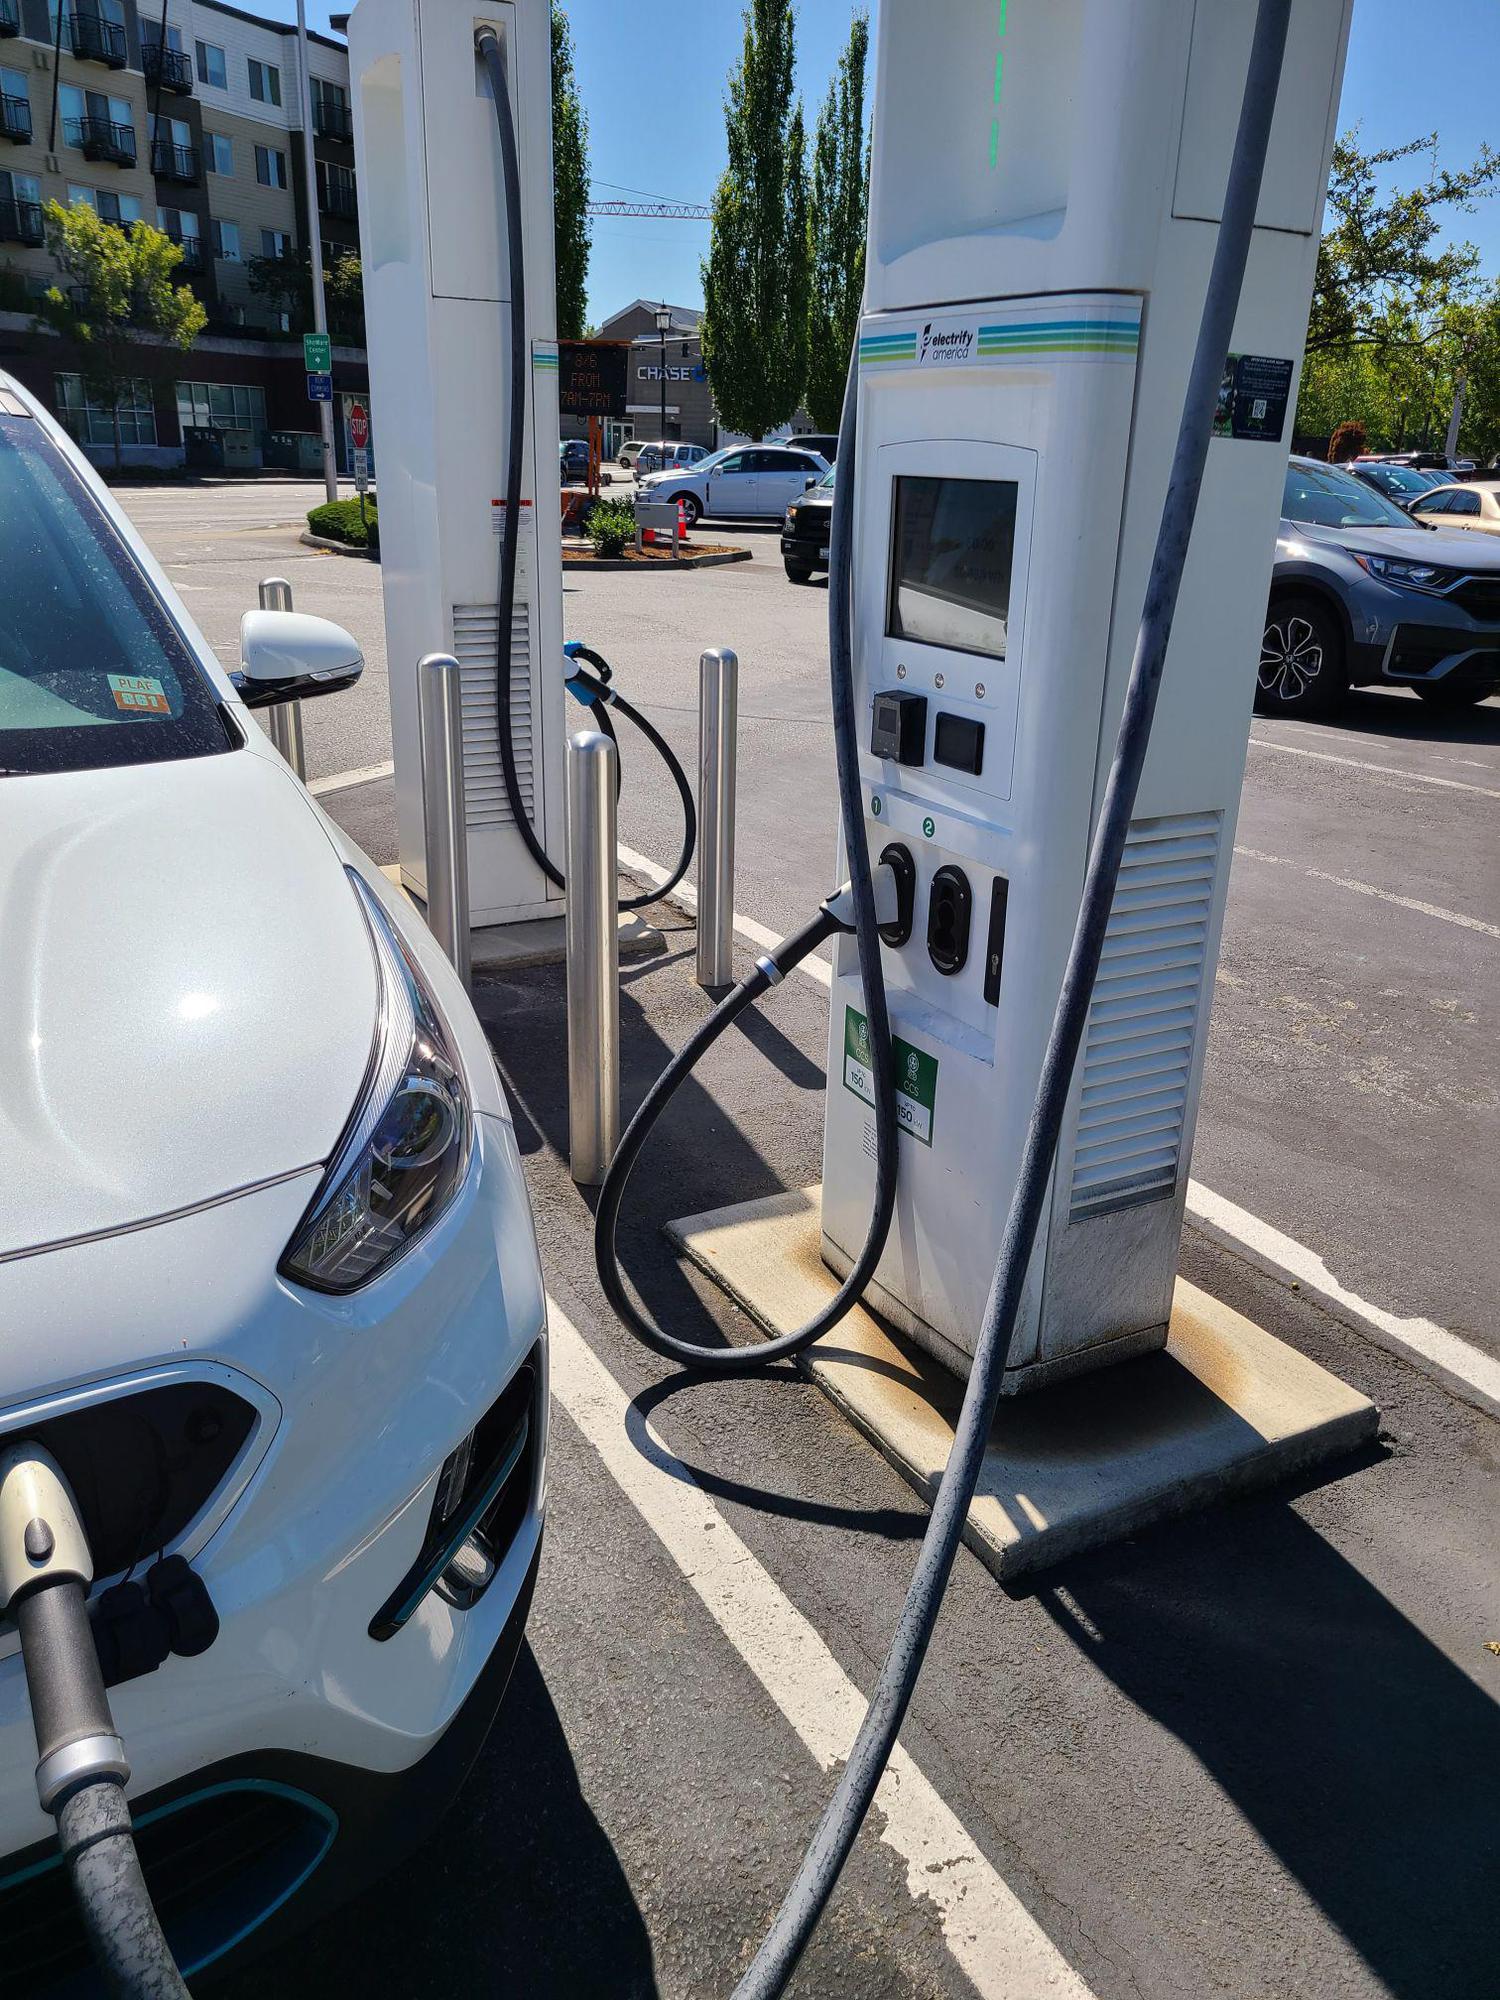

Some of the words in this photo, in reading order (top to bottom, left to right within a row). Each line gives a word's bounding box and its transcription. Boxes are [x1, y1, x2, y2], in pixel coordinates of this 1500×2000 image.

[932, 330, 973, 347] electrify
[932, 347, 969, 360] america
[570, 372, 601, 388] FROM
[637, 366, 690, 381] CHASE
[352, 418, 367, 435] STOP
[874, 800, 879, 813] 1
[925, 820, 933, 835] 2
[855, 1048, 869, 1063] CCS
[850, 1071, 864, 1089] 150
[903, 1080, 920, 1097] CCS
[896, 1104, 913, 1122] 150
